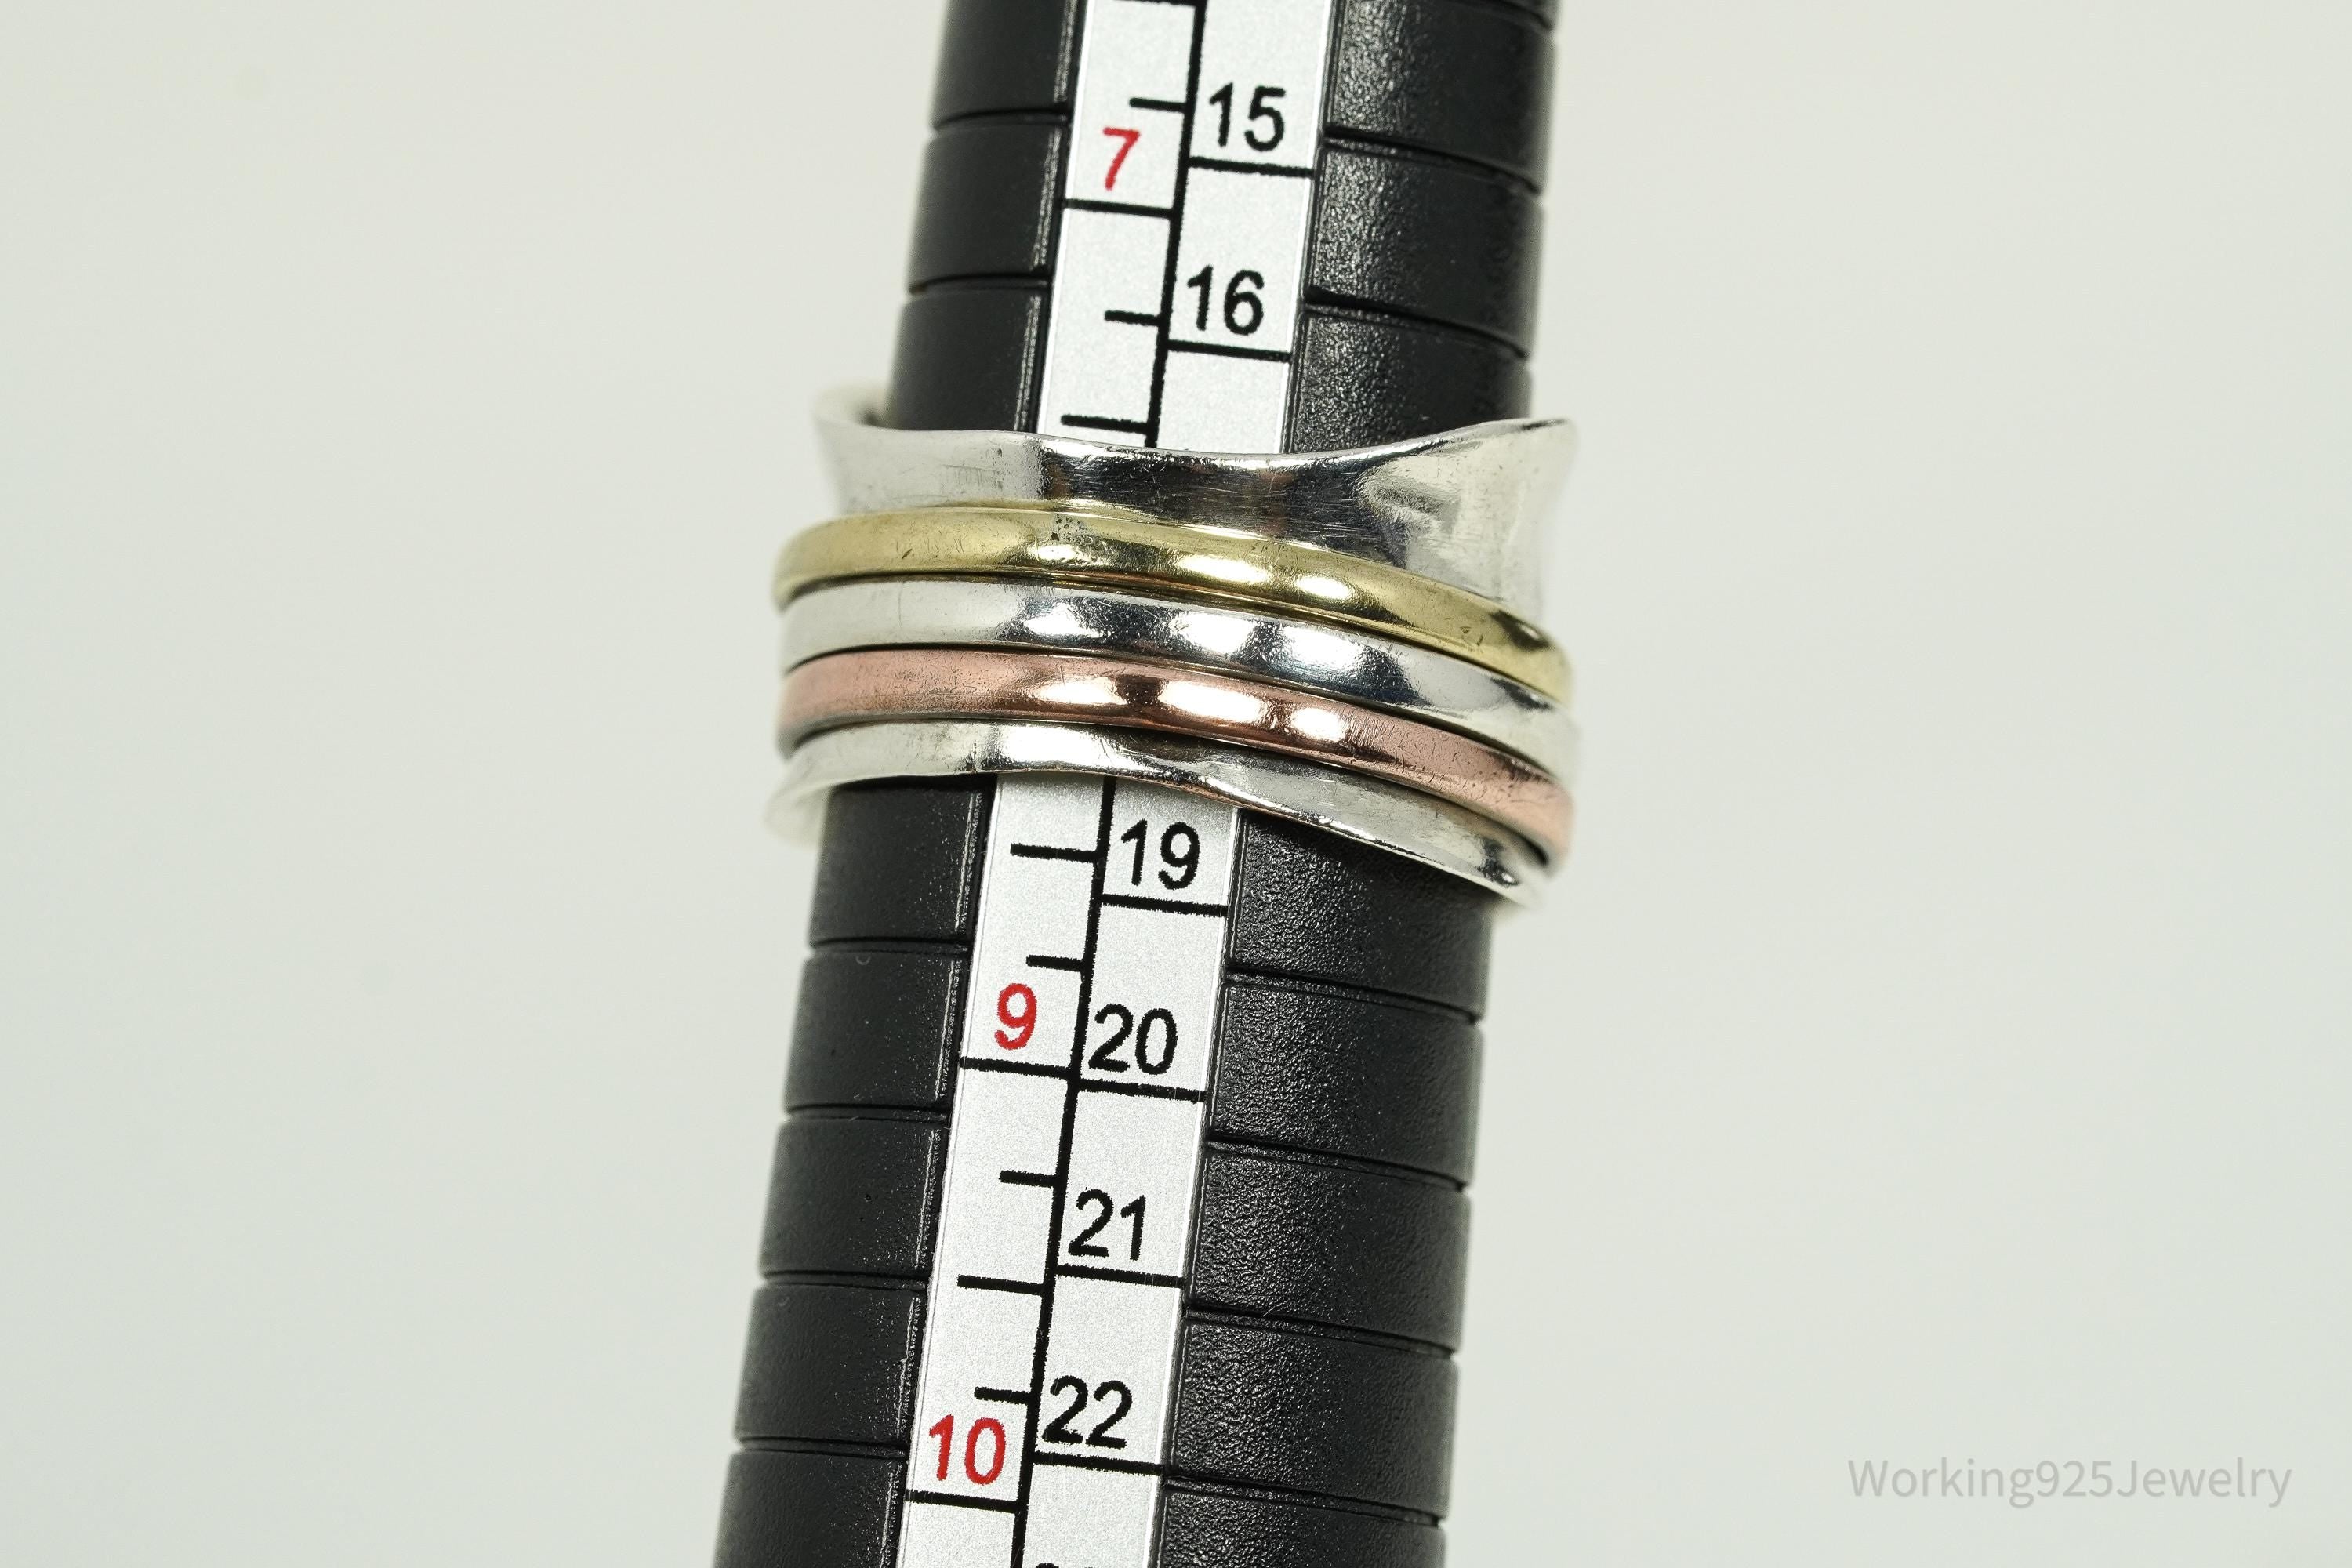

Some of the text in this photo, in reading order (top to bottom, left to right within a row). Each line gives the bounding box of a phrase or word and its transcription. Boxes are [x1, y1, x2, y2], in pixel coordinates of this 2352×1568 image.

[1209, 82, 1286, 151] 15
[1102, 127, 1140, 190] 7
[1187, 265, 1265, 336] 16
[1121, 819, 1200, 890] 19
[994, 983, 1037, 1050] 9
[1088, 1004, 1178, 1075] 20
[1068, 1189, 1146, 1261] 21
[1041, 1375, 1133, 1450] 22
[928, 1414, 1006, 1486] 10
